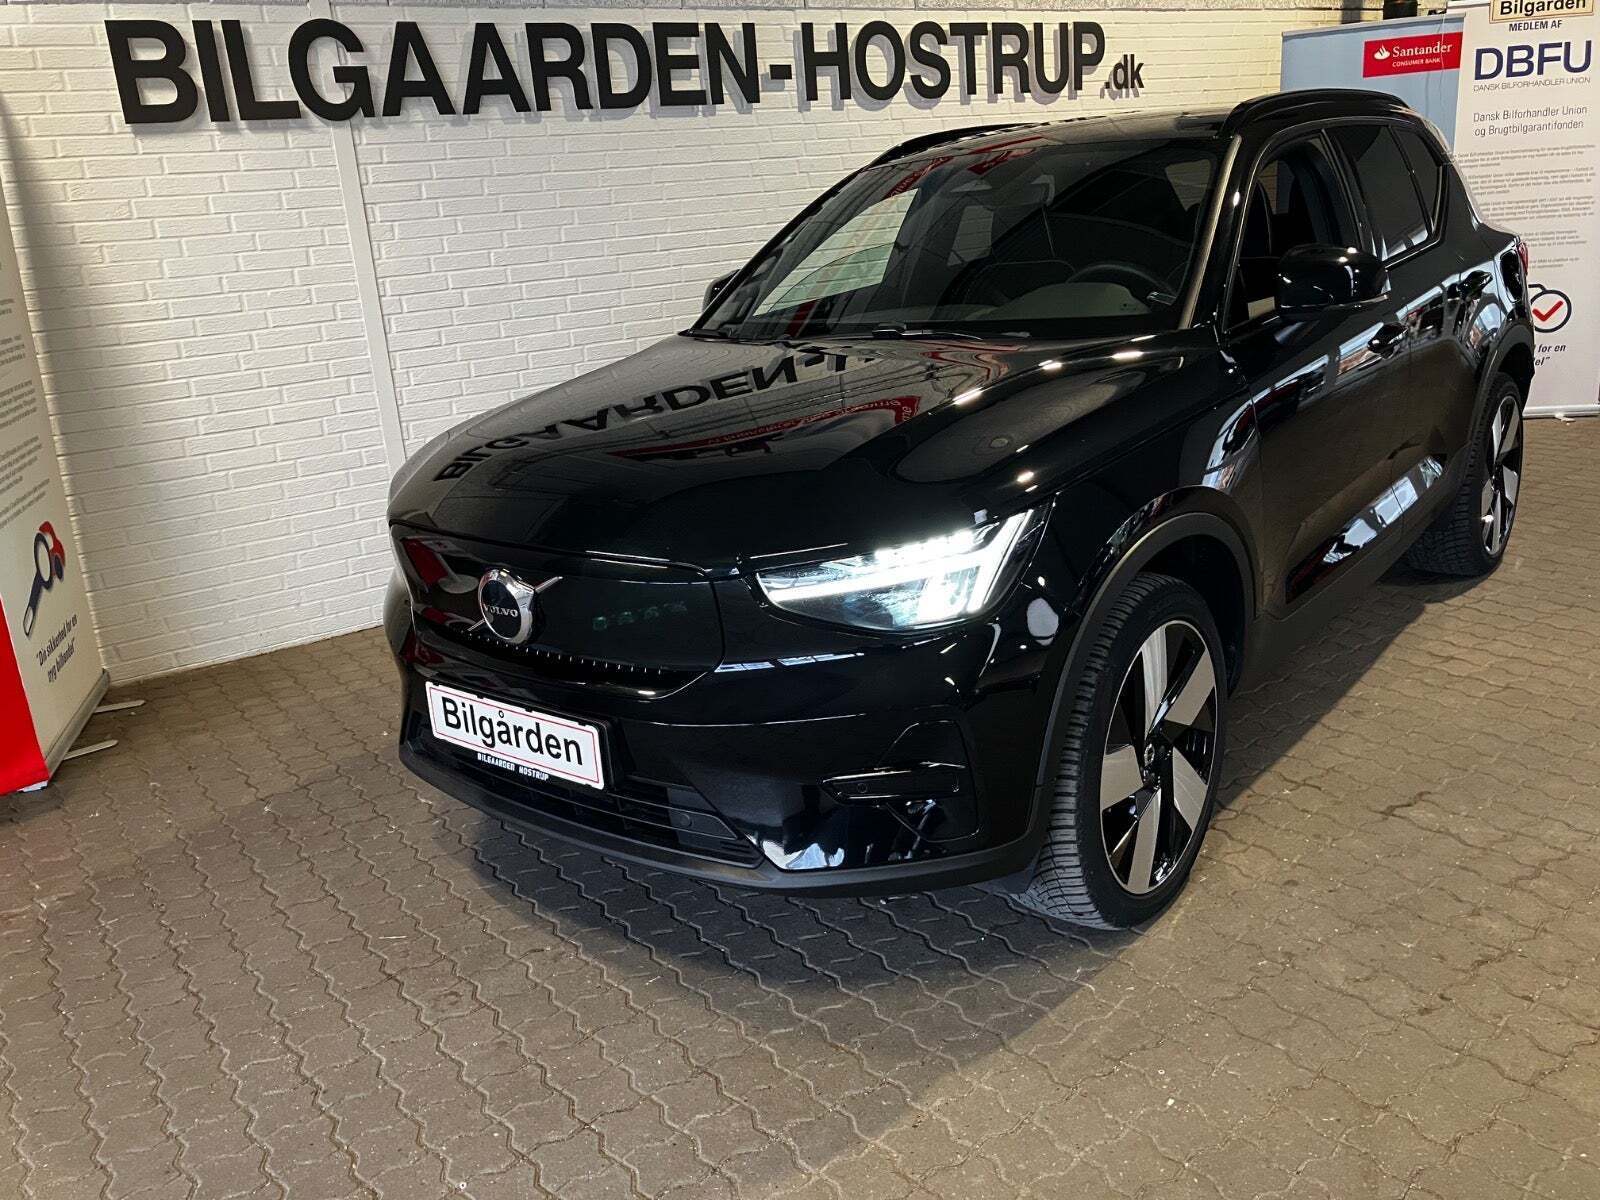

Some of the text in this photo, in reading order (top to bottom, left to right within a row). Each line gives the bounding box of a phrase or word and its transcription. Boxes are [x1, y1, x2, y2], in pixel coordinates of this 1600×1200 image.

[1508, 19, 1563, 32] MEDLEM AF
[1392, 41, 1453, 57] Santander
[1392, 57, 1441, 67] CONSUMER BANK
[1474, 40, 1592, 80] DBFU
[1473, 77, 1591, 92] DANSK BILFORHANDLER UNION
[1473, 105, 1588, 122] Dansk Bilforhandler Union
[1474, 120, 1584, 137] og Brugtbilgarantifonden
[1537, 343, 1567, 353] for en
[482, 602, 519, 618] VOLVO
[441, 696, 584, 766] Bilgården
[477, 752, 549, 781] BILGAARDEN HOSTRUP
